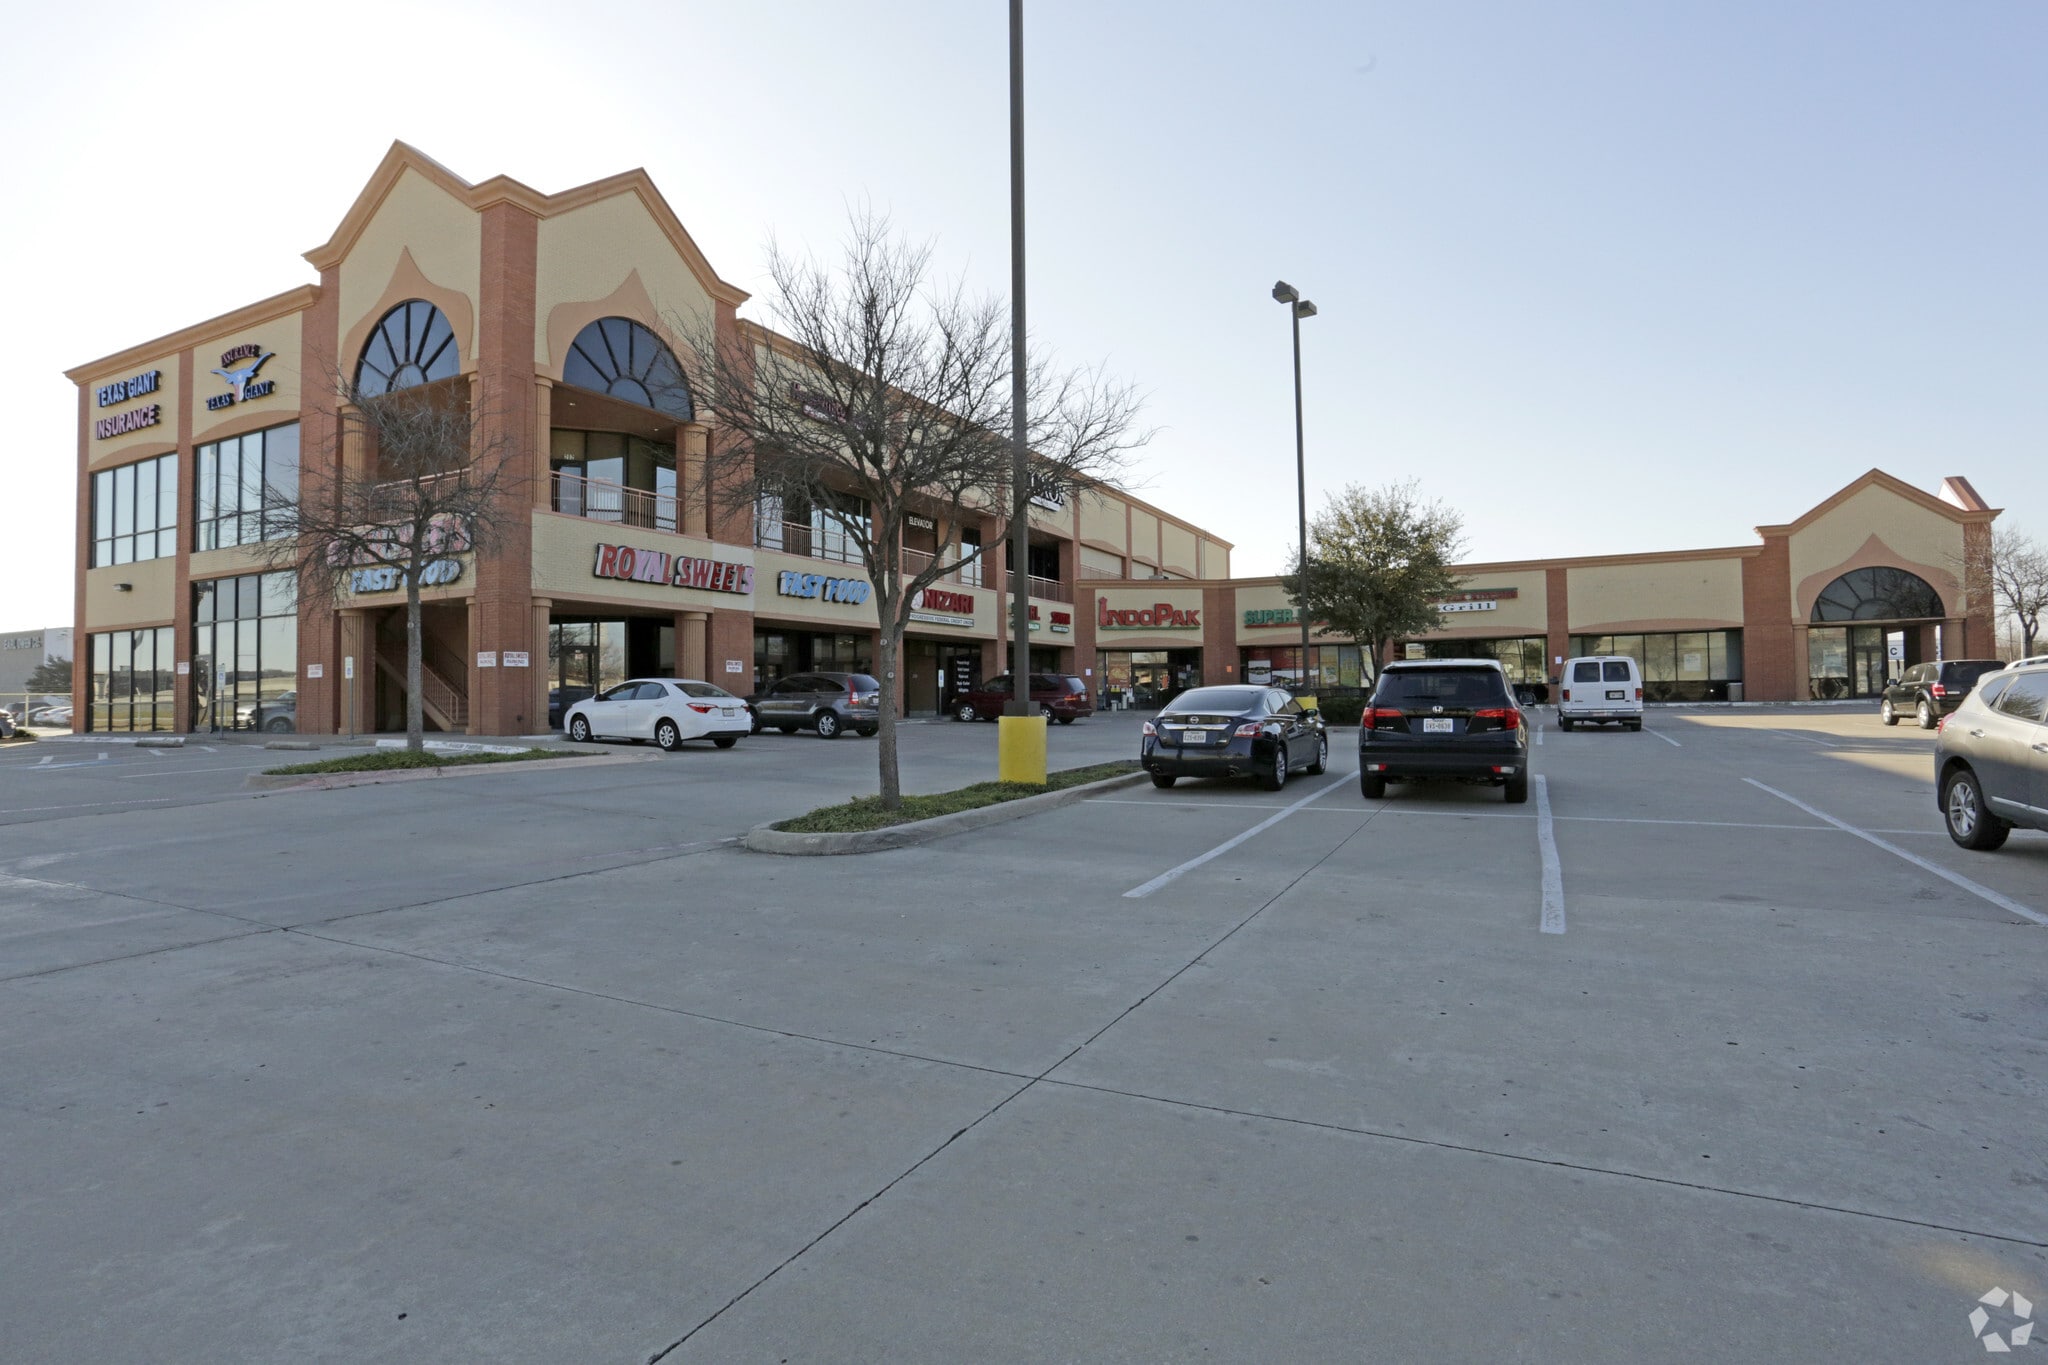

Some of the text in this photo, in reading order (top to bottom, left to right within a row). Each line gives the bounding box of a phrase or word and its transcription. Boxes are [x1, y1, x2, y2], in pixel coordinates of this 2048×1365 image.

[96, 371, 158, 408] TEXAS GIANT
[207, 381, 274, 411] TEXAS GIANT
[96, 405, 157, 440] INSURANCE
[909, 516, 933, 530] ELEVATOR
[595, 543, 754, 594] ROYAL SWEETS
[780, 571, 871, 604] FAST FOOD
[923, 588, 975, 614] NIZARI
[1244, 608, 1293, 625] SUPER
[1442, 602, 1491, 611] Grill
